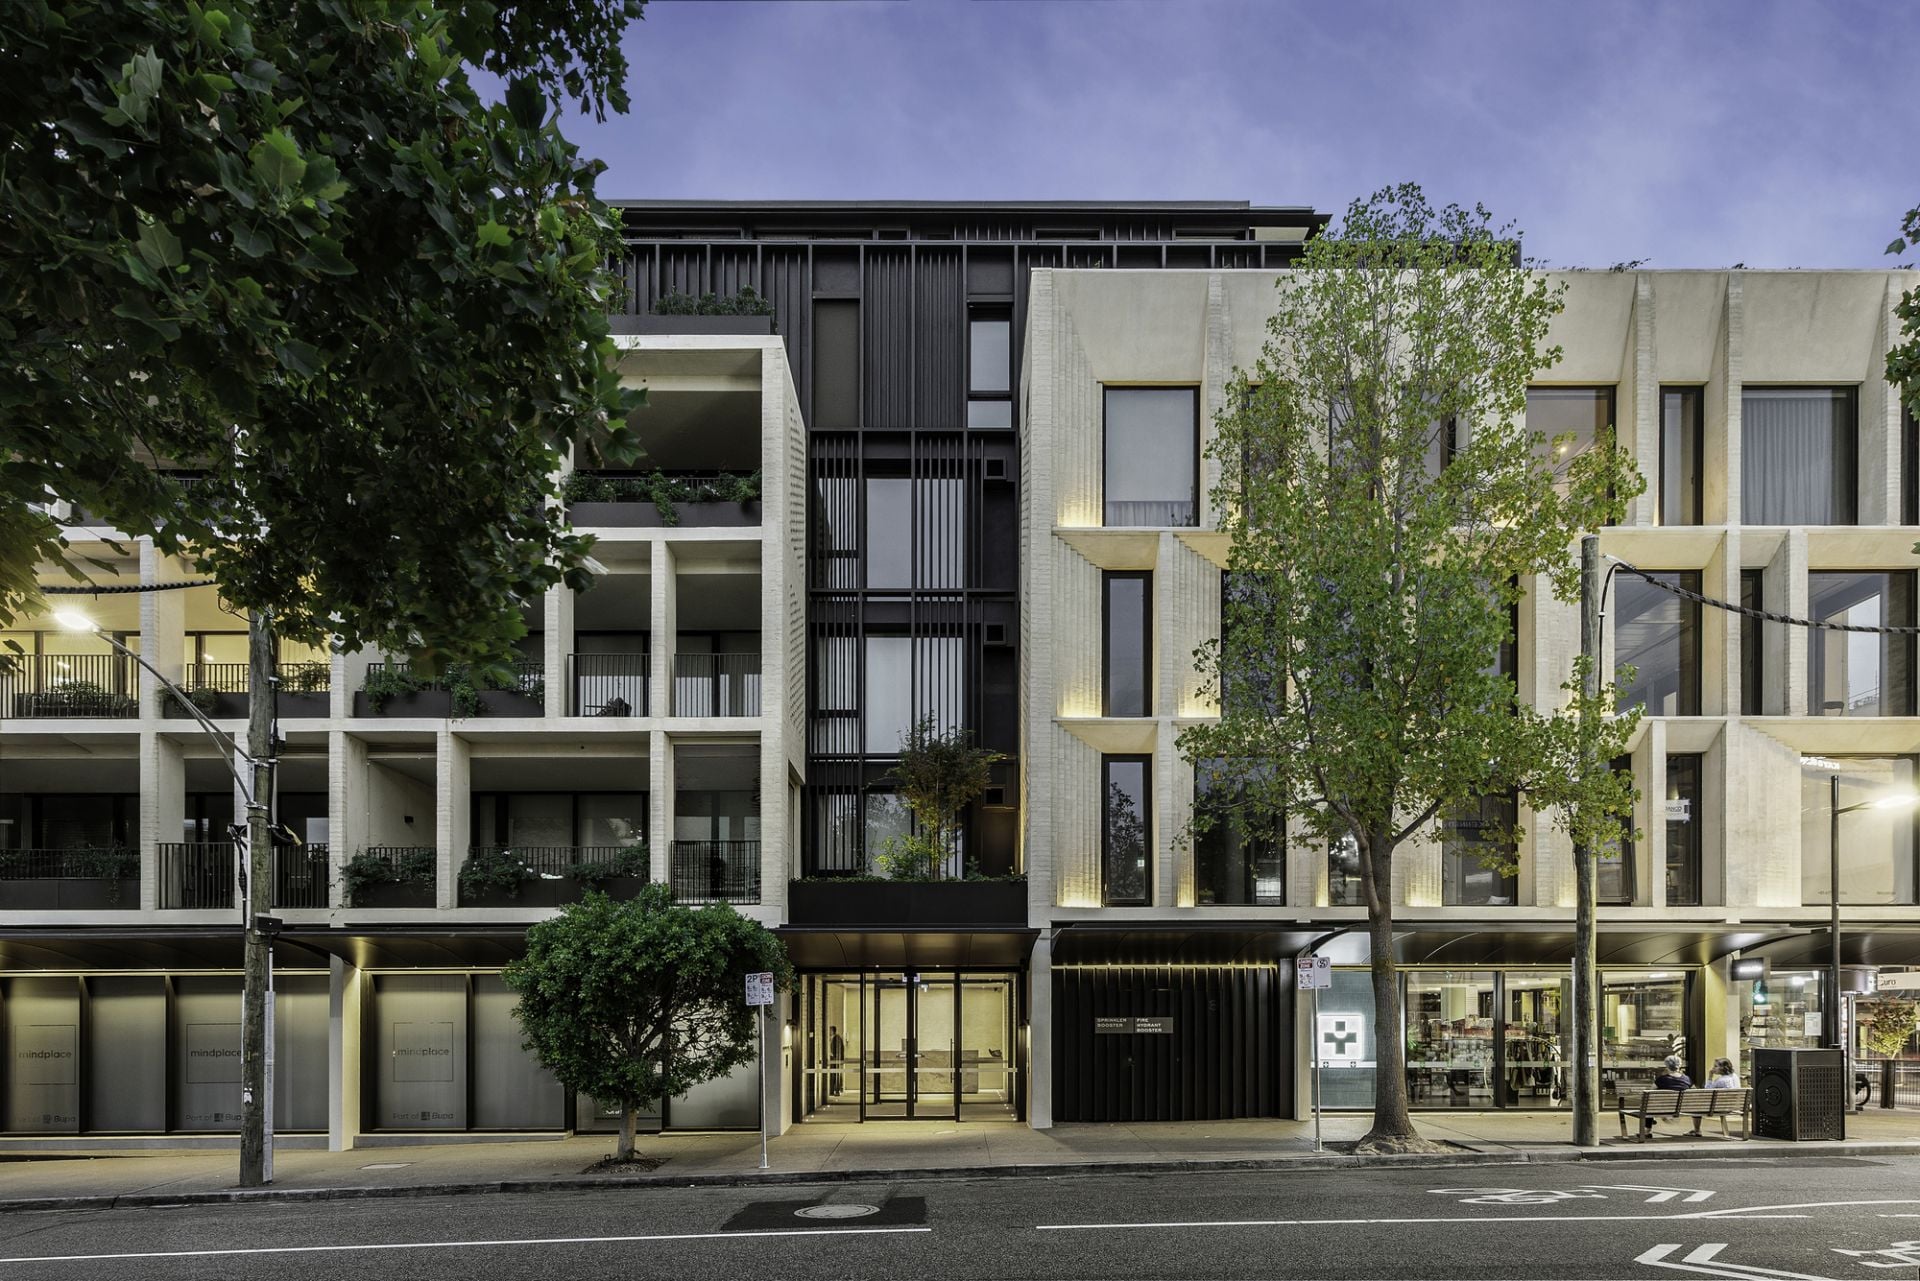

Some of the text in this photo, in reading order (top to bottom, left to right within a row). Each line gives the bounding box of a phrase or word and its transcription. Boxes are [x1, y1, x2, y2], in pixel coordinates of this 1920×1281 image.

[747, 975, 758, 983] 2P
[19, 1050, 72, 1060] mindplace
[397, 1047, 450, 1056] mindplace
[225, 1113, 242, 1121] Bup
